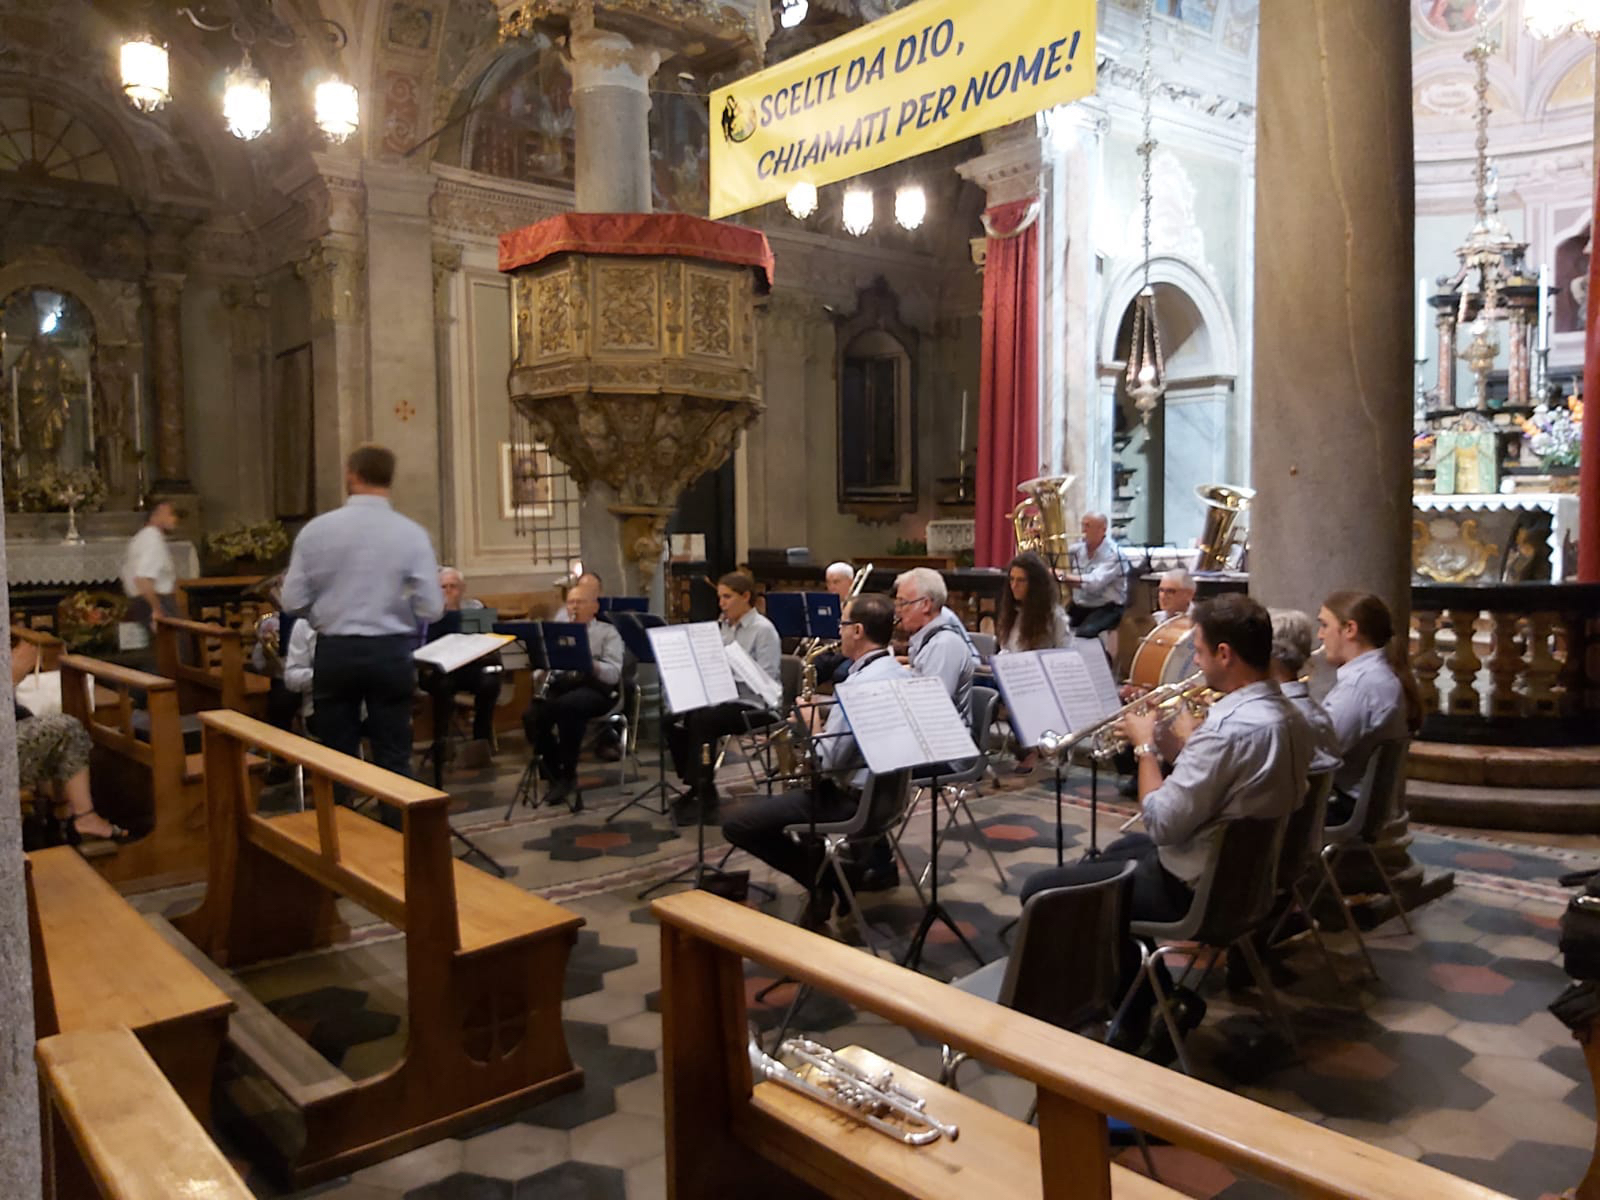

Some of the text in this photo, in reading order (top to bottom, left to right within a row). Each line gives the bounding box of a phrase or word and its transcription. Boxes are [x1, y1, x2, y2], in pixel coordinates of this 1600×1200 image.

[757, 31, 1081, 181] CHIAMATI PER NOME!
[760, 18, 965, 127] SCELTI DA DIO,
